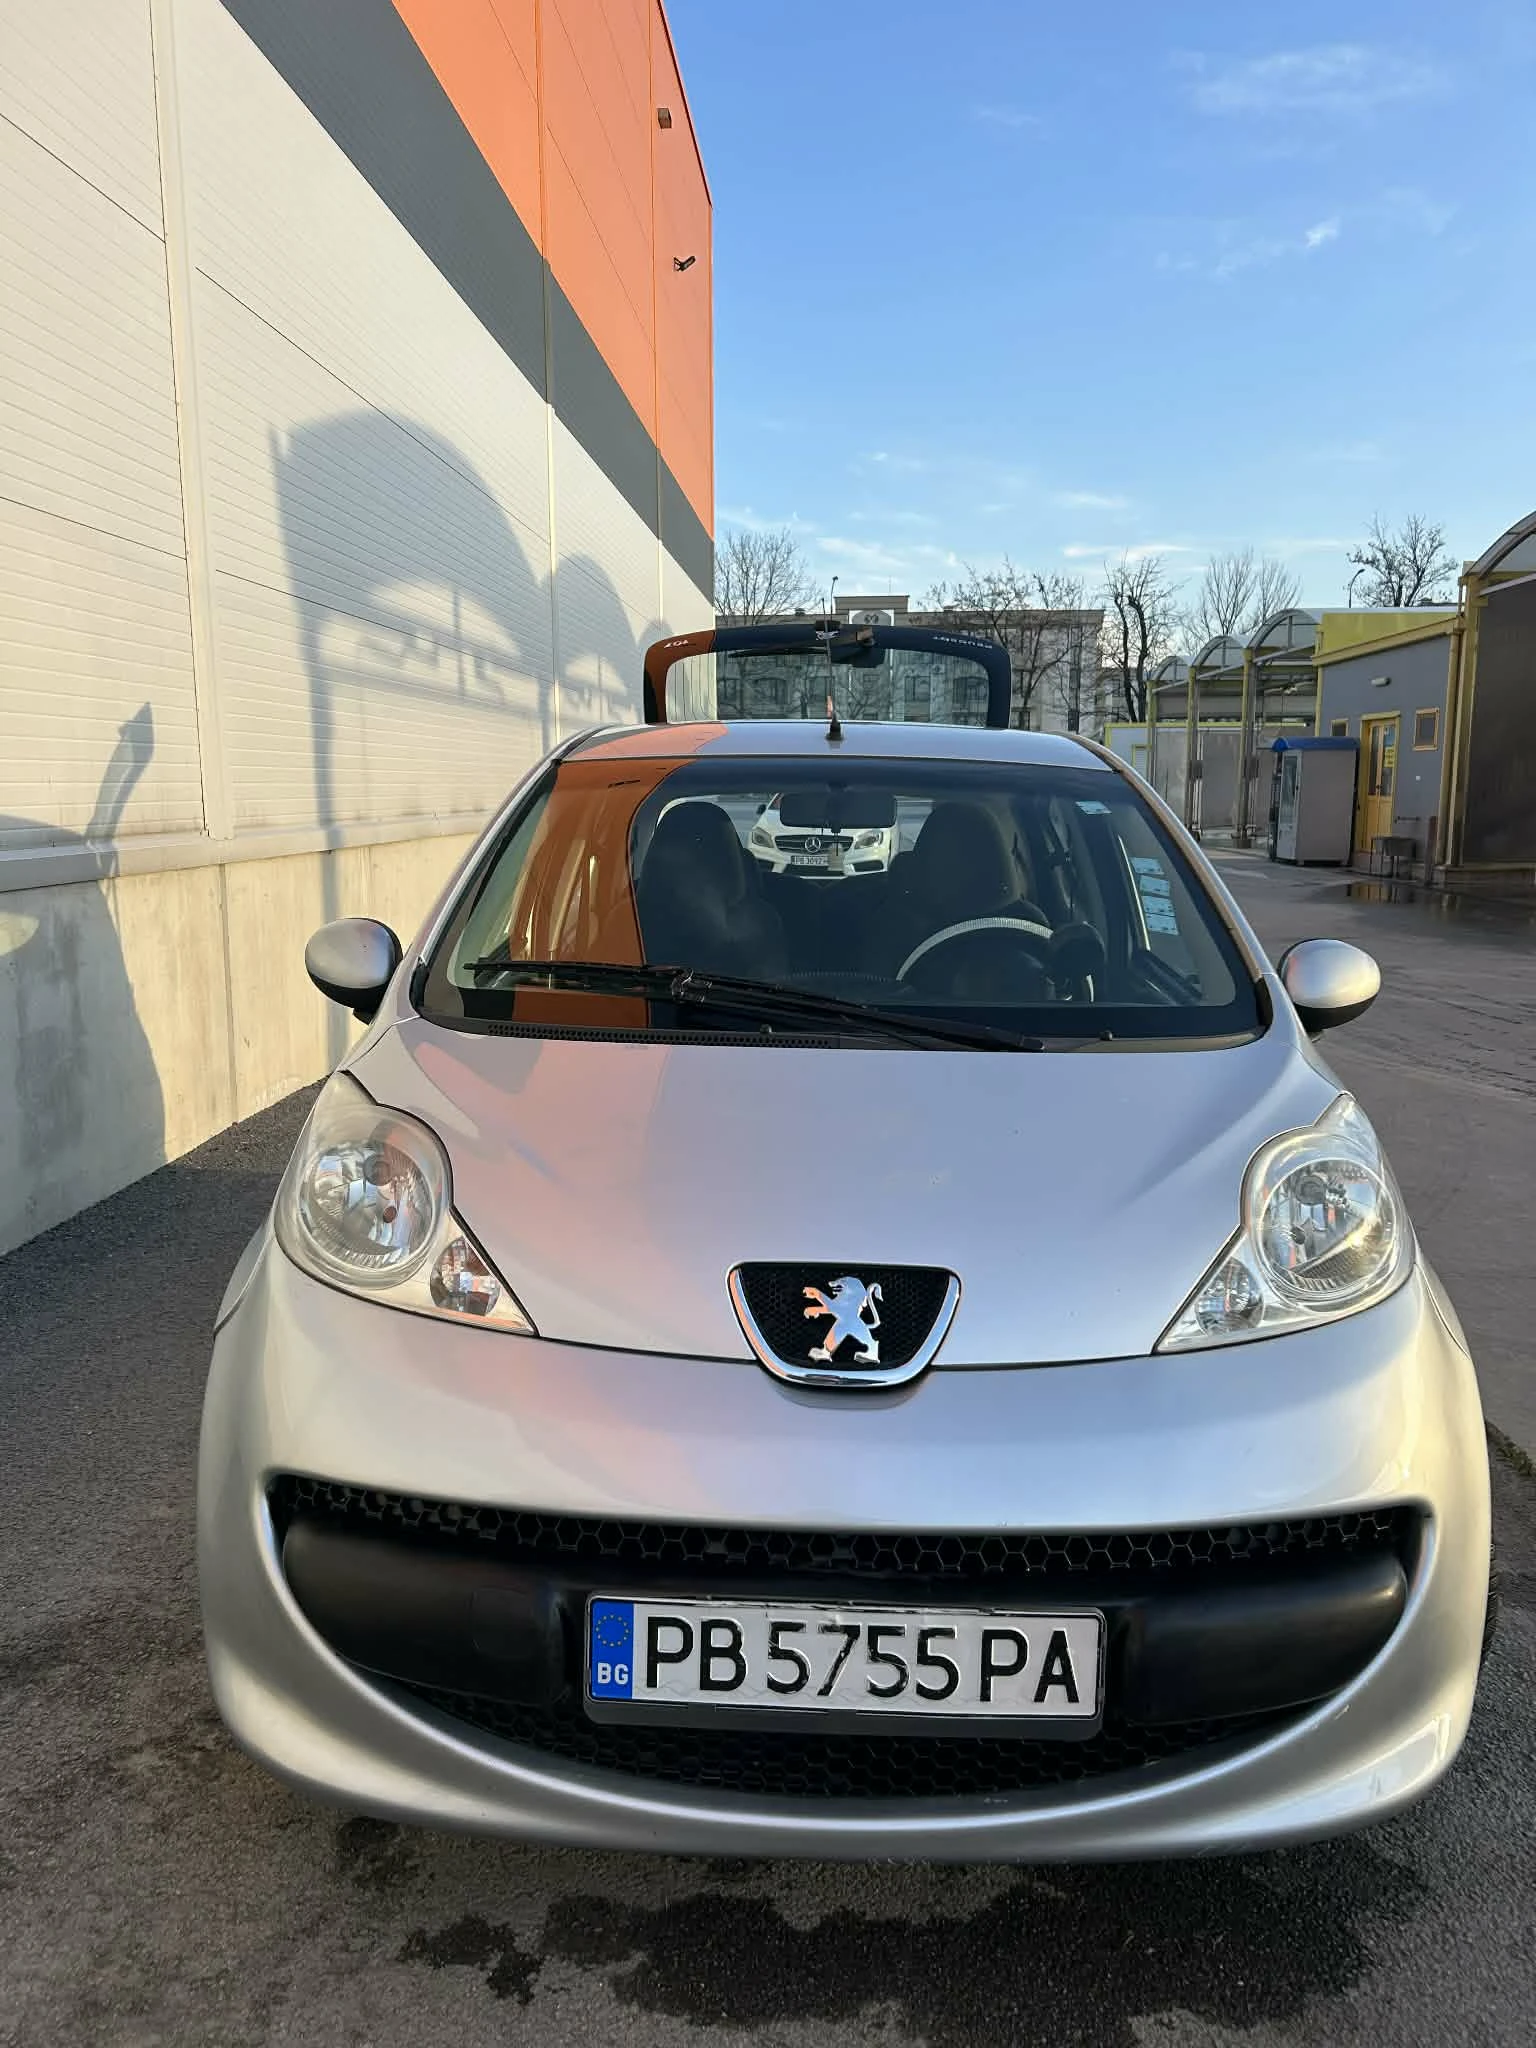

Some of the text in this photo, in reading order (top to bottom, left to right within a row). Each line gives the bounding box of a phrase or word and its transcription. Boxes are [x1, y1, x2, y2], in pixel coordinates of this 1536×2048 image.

[597, 1661, 630, 1685] BG
[646, 1616, 1081, 1704] PB 5755 PA
